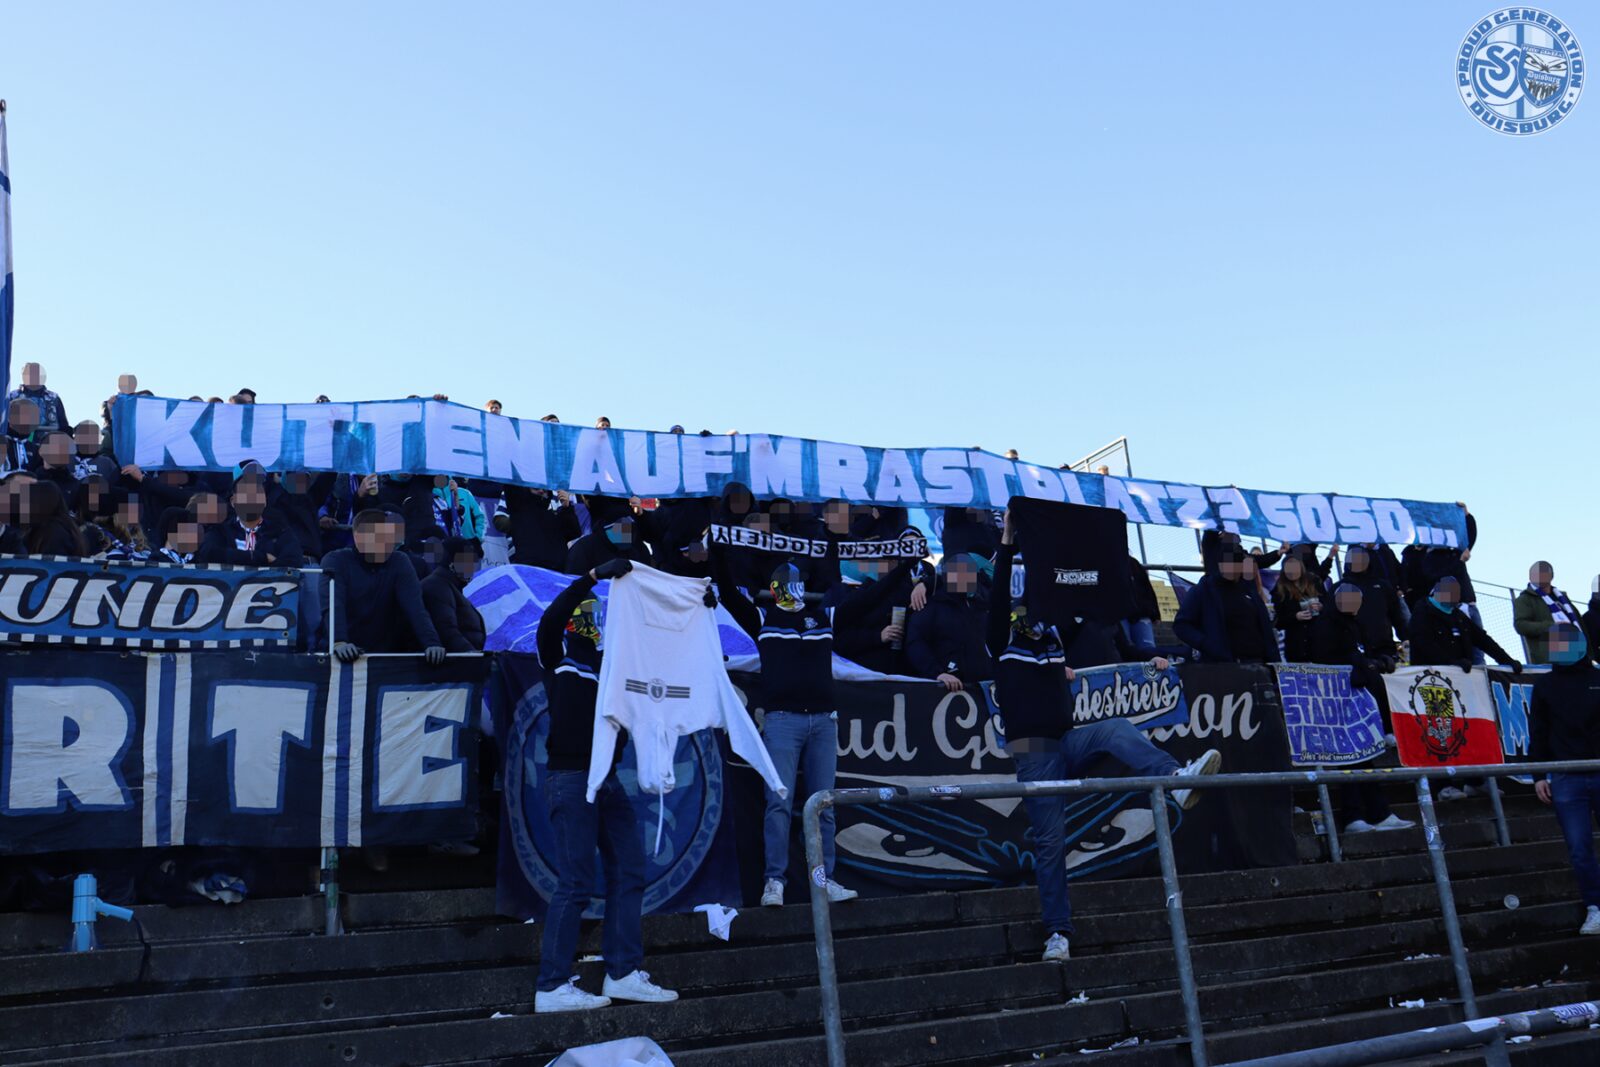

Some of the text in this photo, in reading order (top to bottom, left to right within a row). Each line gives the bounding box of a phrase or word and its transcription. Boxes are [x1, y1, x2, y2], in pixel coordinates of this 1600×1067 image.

[134, 400, 548, 484] KUTTEN
[569, 431, 809, 497] AUF'M
[1259, 493, 1458, 545] SOSO...
[712, 525, 826, 556] SOCIETY
[0, 573, 298, 630] UNDE
[1073, 671, 1181, 723] deskreis
[1287, 711, 1385, 754] VERBOT
